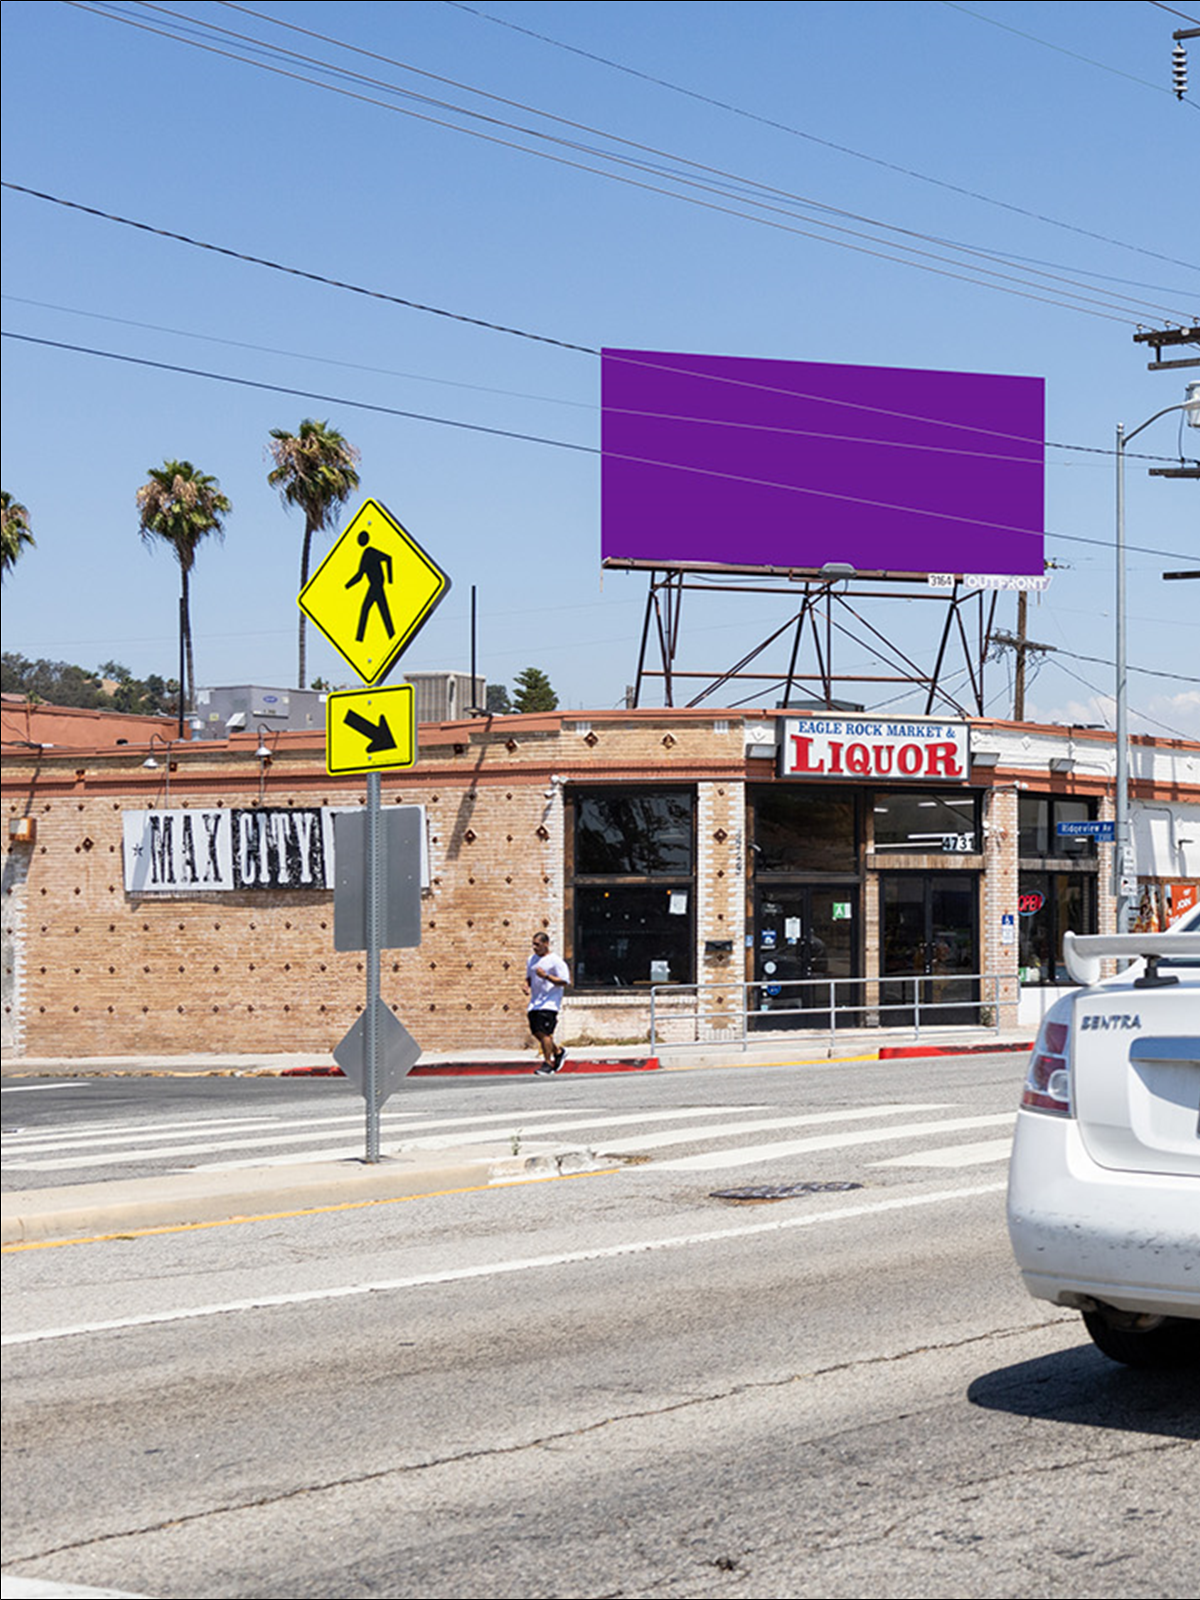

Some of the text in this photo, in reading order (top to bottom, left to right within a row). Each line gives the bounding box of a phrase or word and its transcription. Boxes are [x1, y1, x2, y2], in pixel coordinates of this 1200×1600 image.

[929, 575, 951, 587] 3164
[967, 576, 1048, 589] OUTFRONT
[798, 720, 957, 739] EAGLE ROCK MARKET &
[790, 734, 963, 777] LIQUOR
[1061, 823, 1100, 835] Ridgeview
[150, 813, 224, 884] MAX
[239, 811, 315, 885] CITY
[942, 836, 975, 851] 4731
[1080, 1014, 1142, 1031] SENTRA
